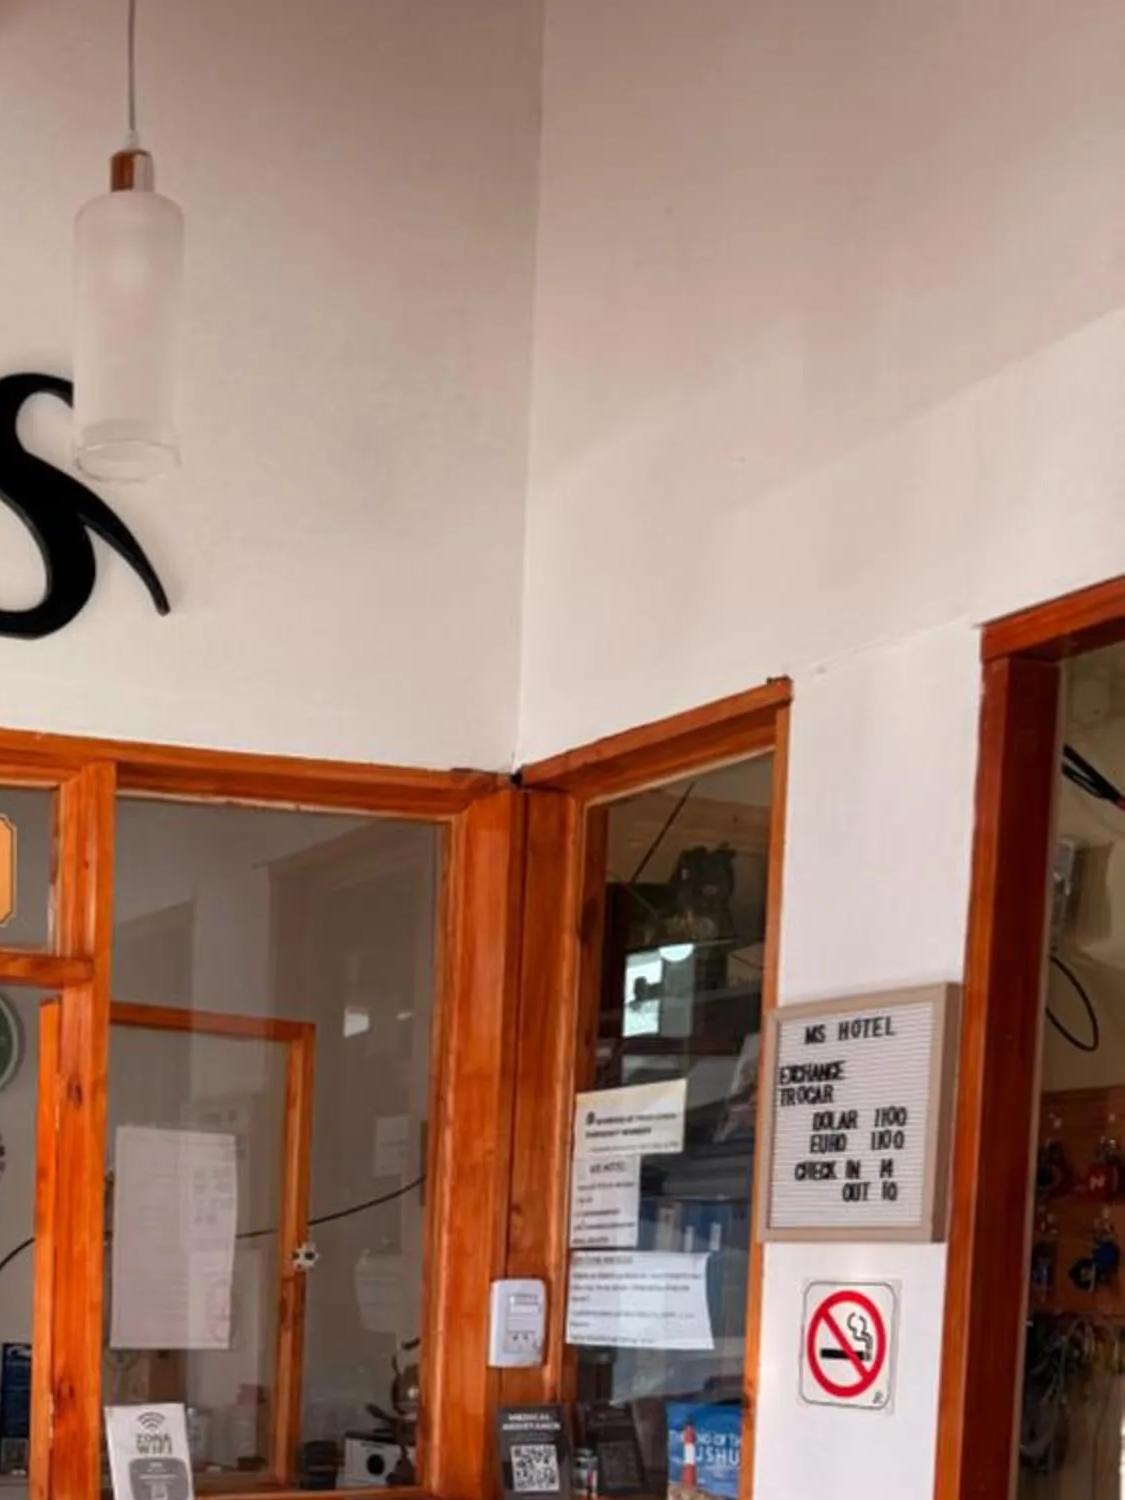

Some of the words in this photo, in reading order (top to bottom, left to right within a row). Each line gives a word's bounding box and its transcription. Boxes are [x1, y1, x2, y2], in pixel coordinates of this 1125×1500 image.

[804, 1024, 826, 1045] MS
[838, 1016, 895, 1041] HOTEL
[812, 1109, 858, 1131] DOLAR
[809, 1133, 847, 1154] EURO
[794, 1160, 837, 1181] CHECK
[845, 1159, 861, 1180] IN
[842, 1182, 871, 1202] OUT
